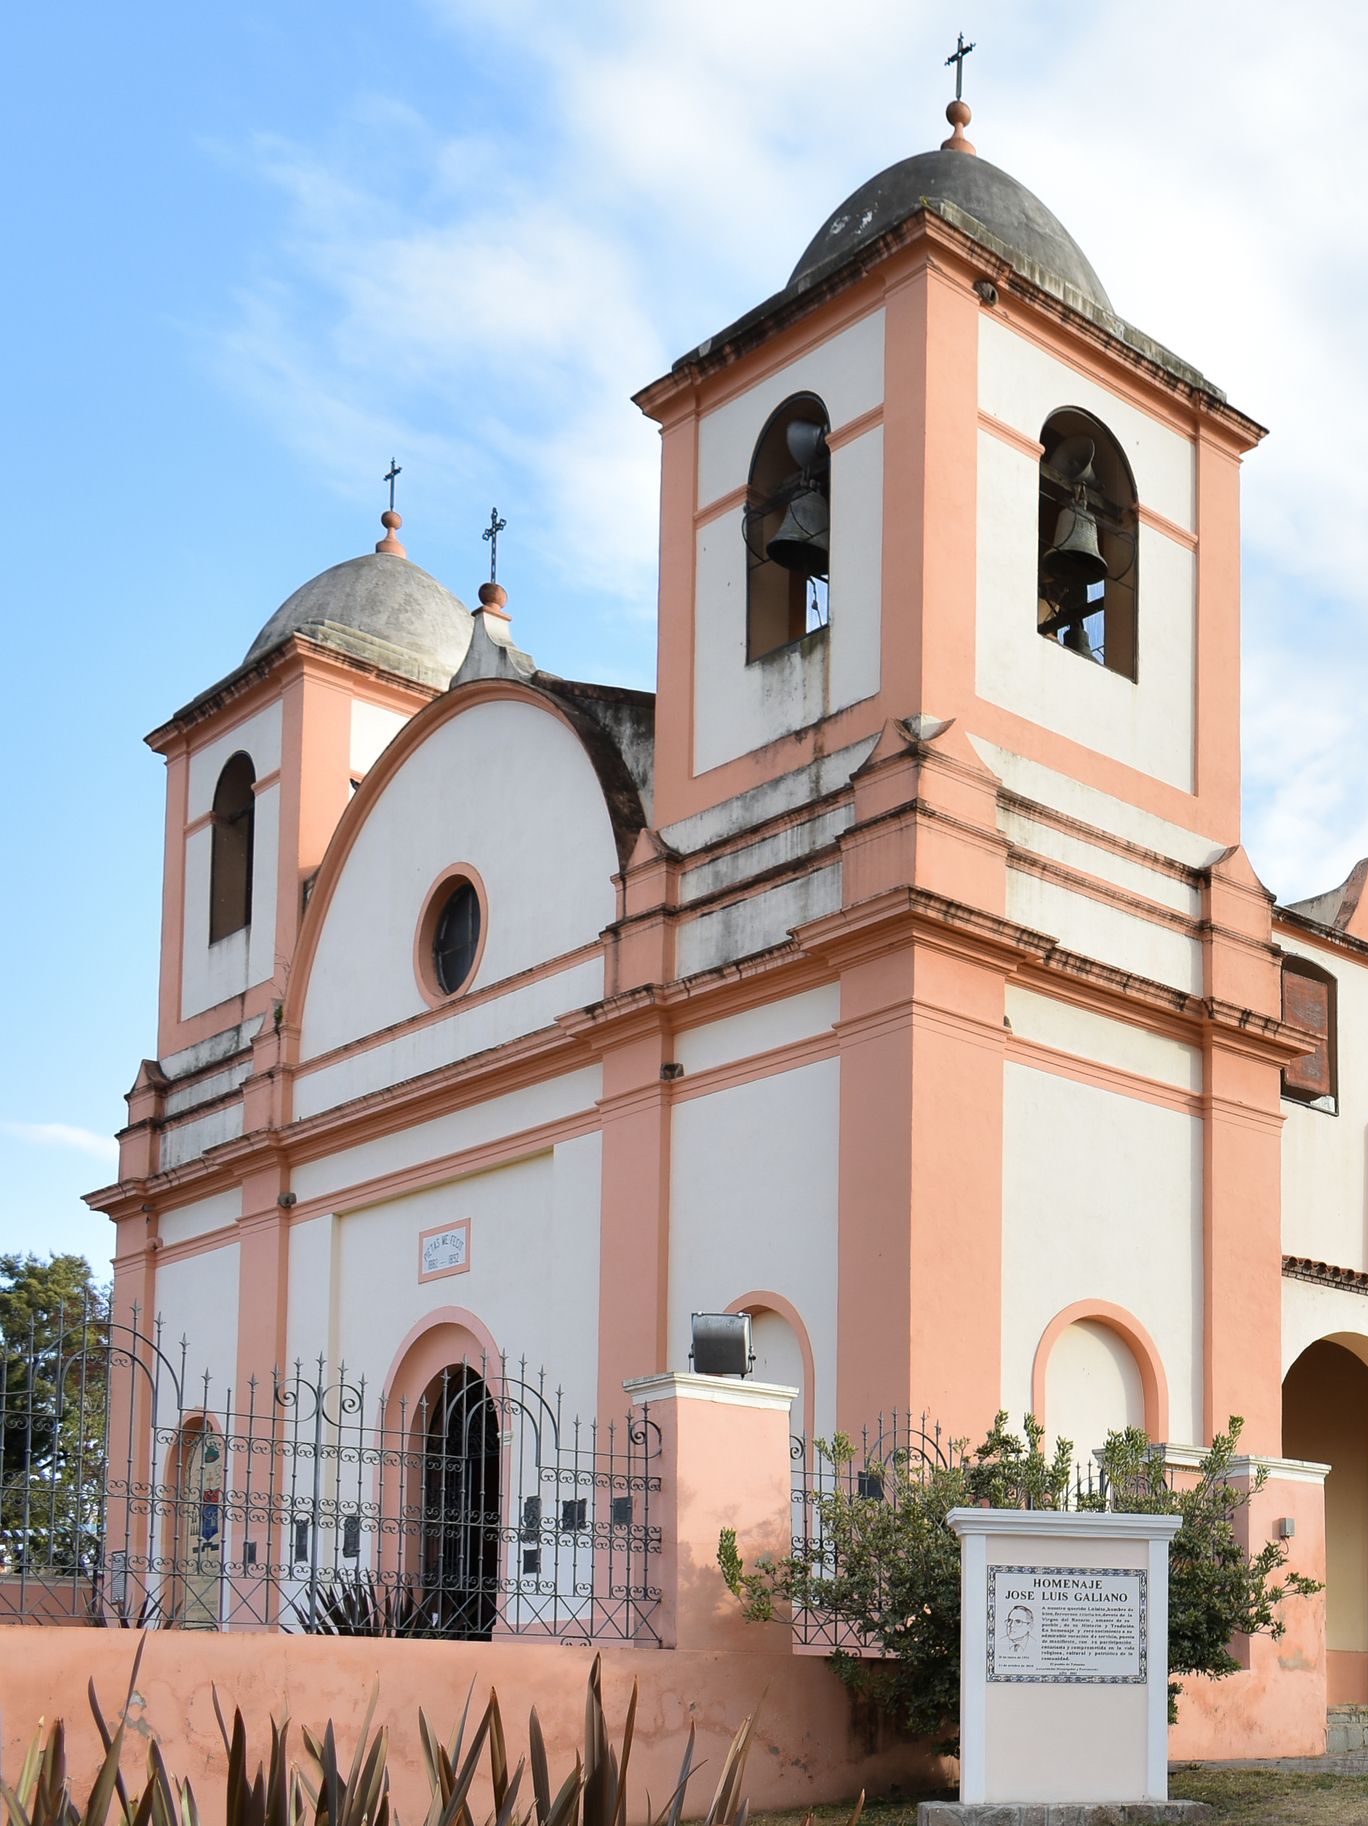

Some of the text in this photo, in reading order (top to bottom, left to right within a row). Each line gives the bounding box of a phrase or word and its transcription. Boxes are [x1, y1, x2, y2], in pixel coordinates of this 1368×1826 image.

[442, 1234, 448, 1245] ME
[1033, 1578, 1103, 1589] HOMENAJE
[1005, 1590, 1128, 1602] JOSE LUIS GALIANO
